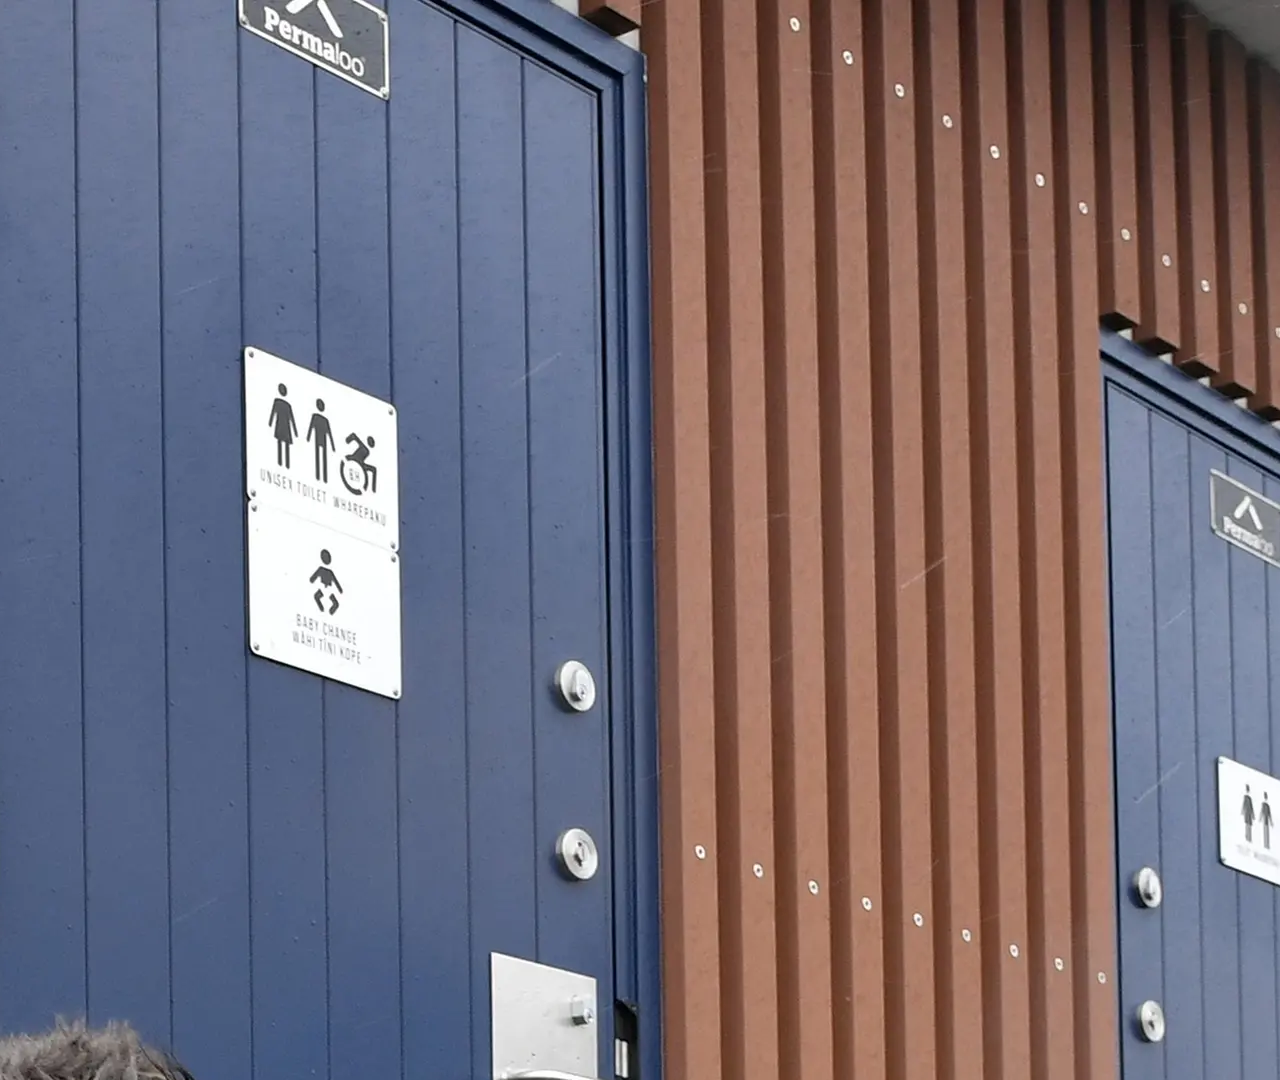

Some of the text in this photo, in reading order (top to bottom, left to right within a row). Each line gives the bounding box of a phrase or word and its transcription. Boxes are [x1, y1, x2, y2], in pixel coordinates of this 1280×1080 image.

[260, 468, 294, 494] UNISEX
[297, 481, 327, 504] TOILET
[296, 613, 357, 645] BABY CHANGE
